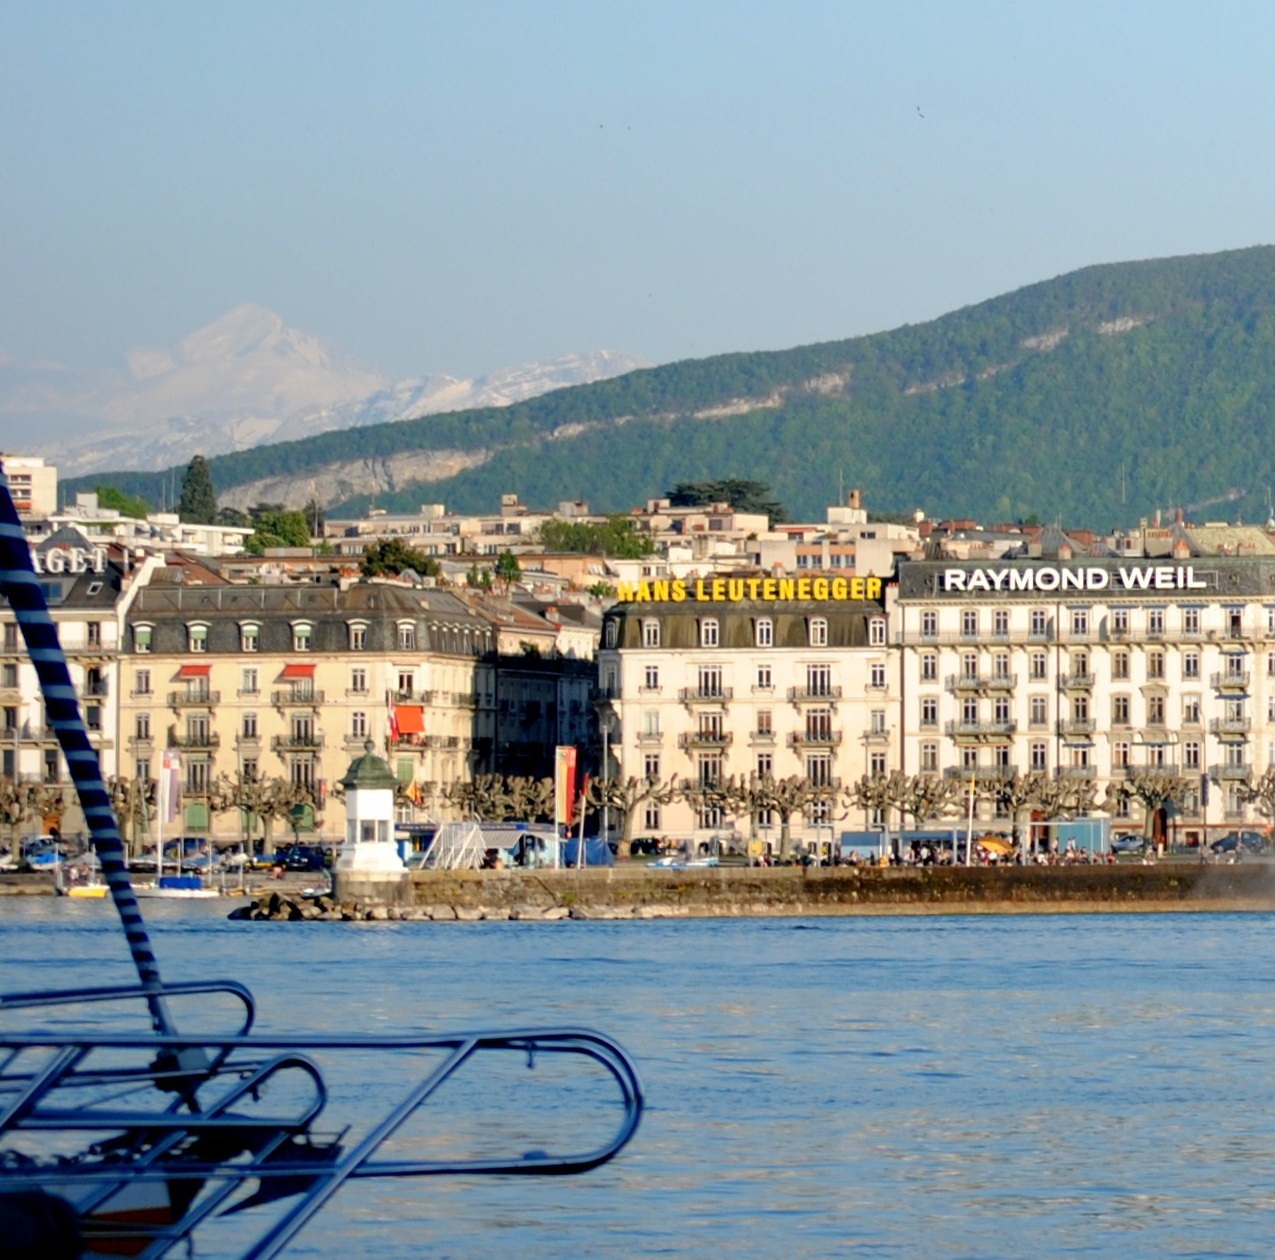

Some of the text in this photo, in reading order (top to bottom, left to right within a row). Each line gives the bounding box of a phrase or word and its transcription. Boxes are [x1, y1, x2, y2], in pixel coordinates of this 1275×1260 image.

[618, 577, 882, 602] HANS LEUTENEGGER
[944, 566, 1207, 590] RAYMOND WEIL
